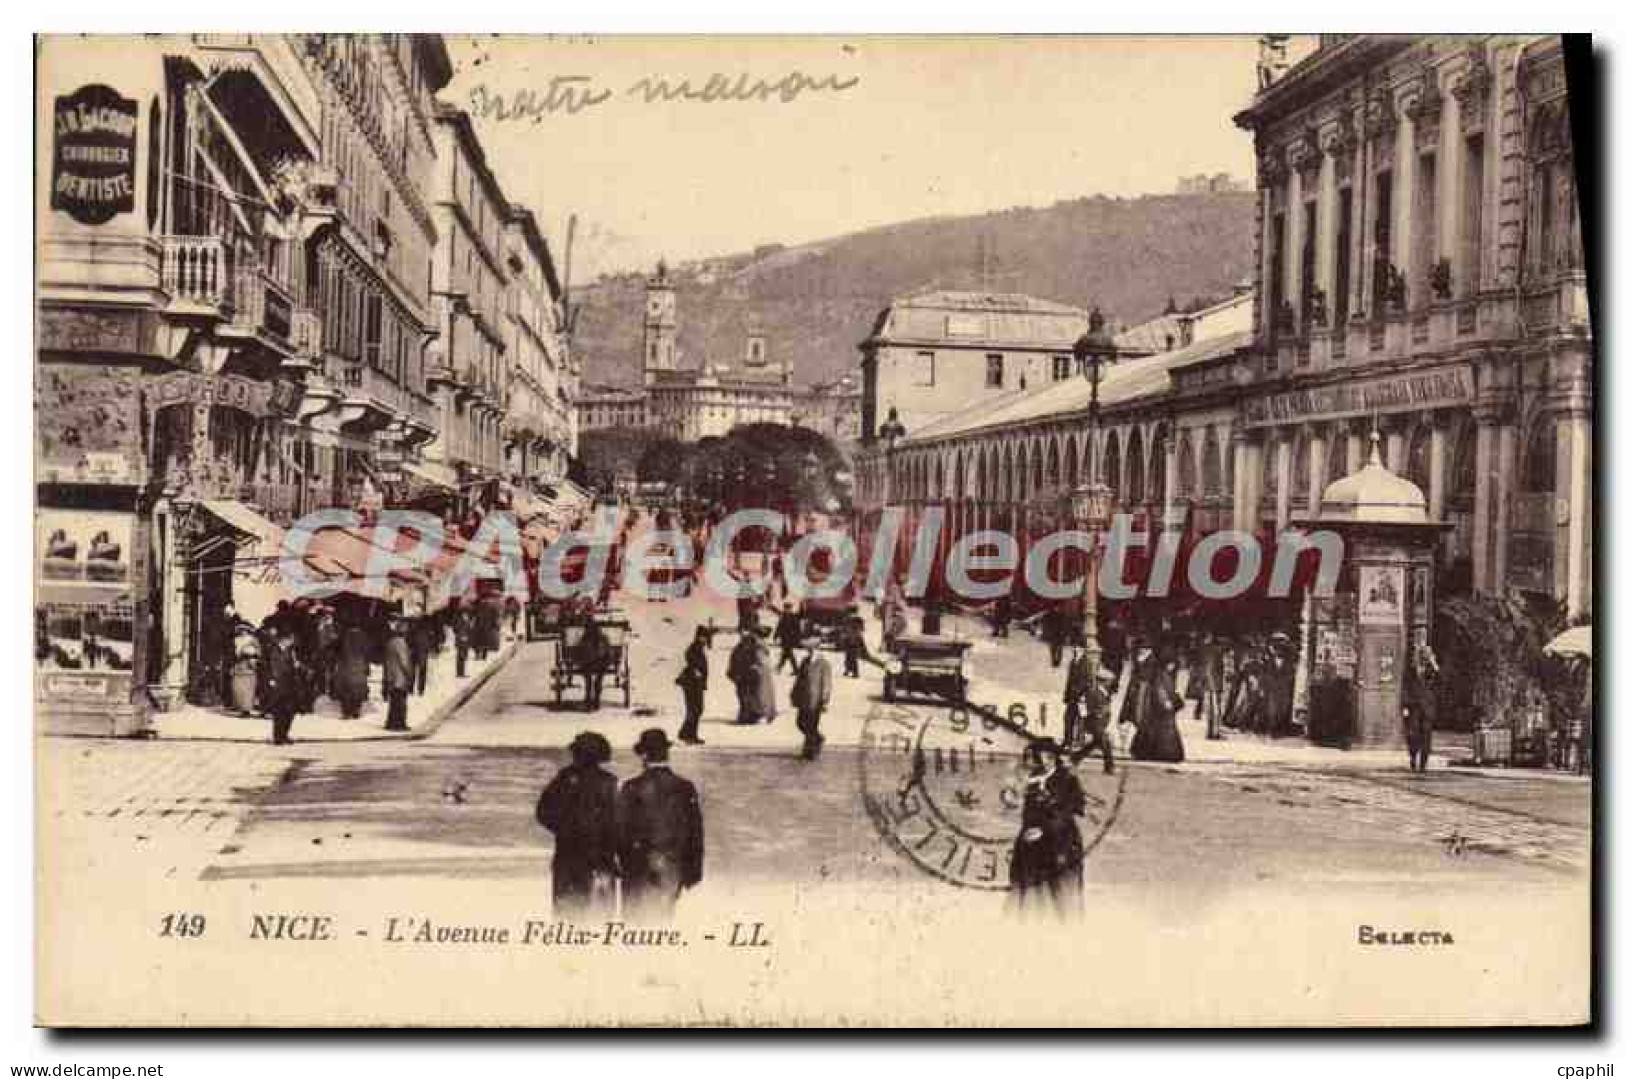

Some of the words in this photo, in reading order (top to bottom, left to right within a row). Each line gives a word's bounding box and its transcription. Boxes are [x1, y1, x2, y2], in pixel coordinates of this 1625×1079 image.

[57, 172, 134, 201] DENTISTE
[159, 913, 206, 938] 149
[383, 917, 510, 944] L'Avenue
[520, 919, 689, 947] Félix-Faure.
